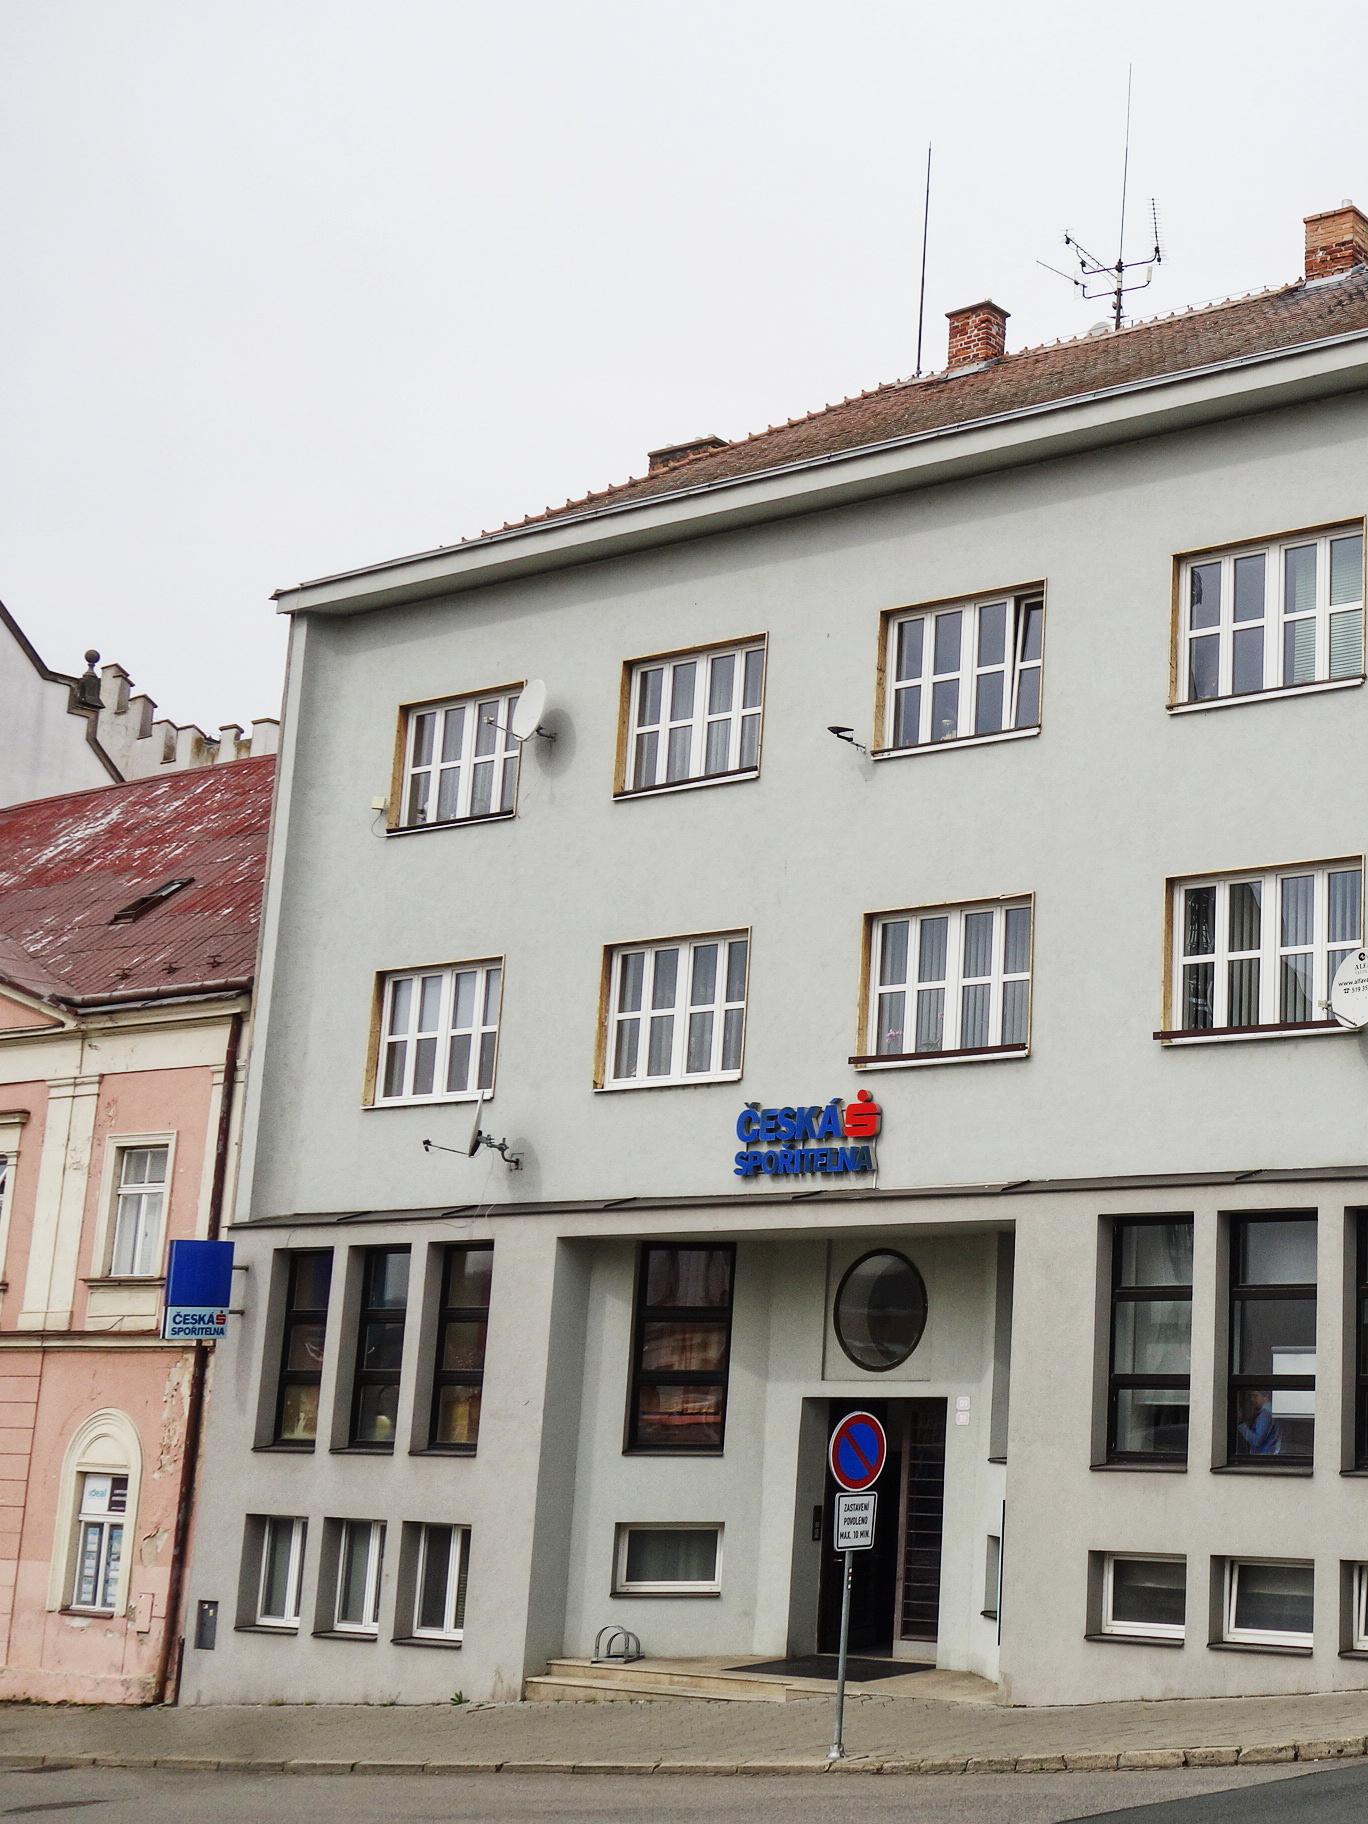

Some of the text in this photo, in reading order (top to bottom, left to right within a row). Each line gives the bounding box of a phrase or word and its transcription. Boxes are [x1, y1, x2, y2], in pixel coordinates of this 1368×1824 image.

[736, 1097, 844, 1143] ČESKÁ
[733, 1143, 874, 1176] SPOŘITELNA
[172, 1311, 215, 1325] ČESKÁ
[171, 1326, 225, 1336] SPOŘITELNA
[843, 1501, 870, 1513] ZASTAVENÍ
[843, 1516, 869, 1526] POVOLENO
[839, 1530, 870, 1540] MAX. 10 MIN.
